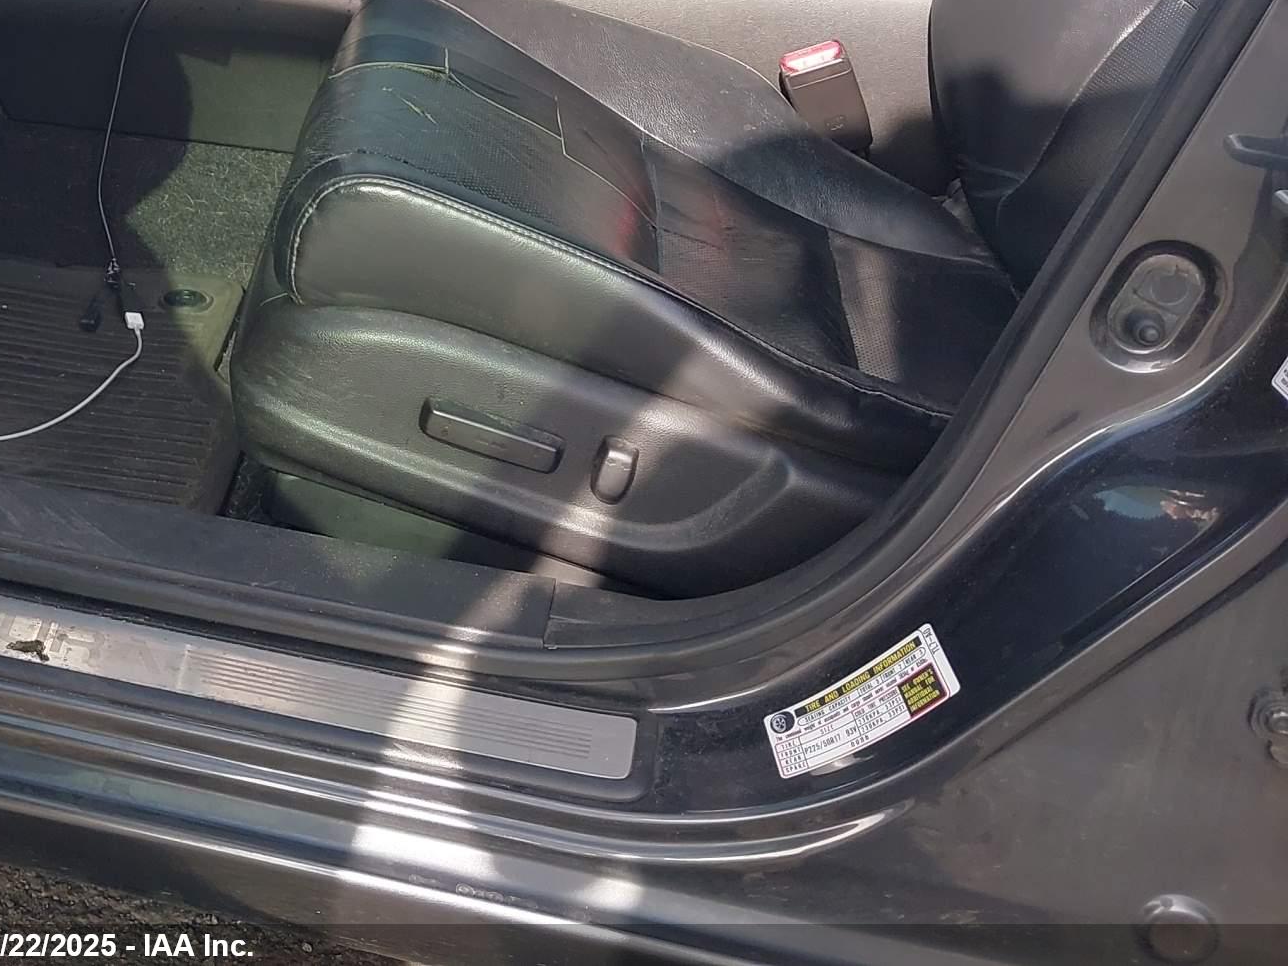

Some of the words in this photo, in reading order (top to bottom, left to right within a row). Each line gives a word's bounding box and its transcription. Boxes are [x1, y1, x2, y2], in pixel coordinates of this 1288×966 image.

[804, 699, 821, 713] TIRE
[824, 691, 840, 704] AND
[841, 672, 871, 694] LOADING
[872, 641, 917, 674] INFORMATION
